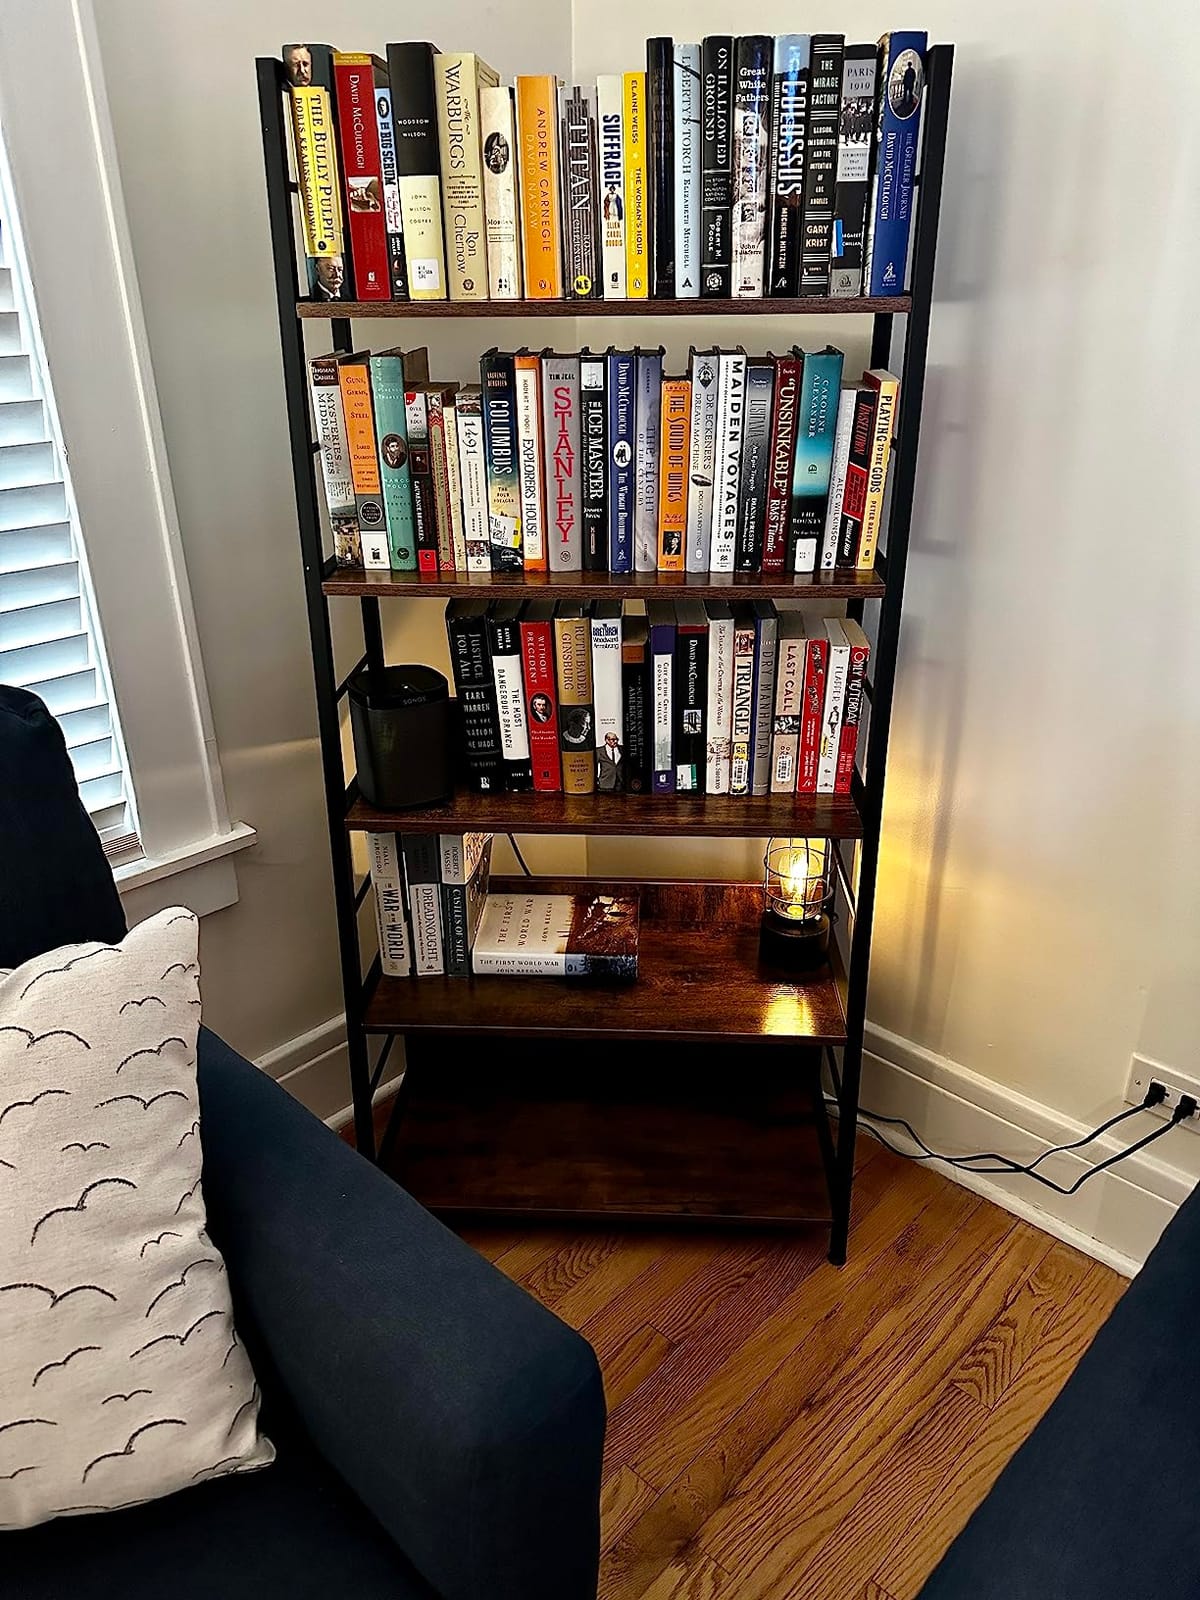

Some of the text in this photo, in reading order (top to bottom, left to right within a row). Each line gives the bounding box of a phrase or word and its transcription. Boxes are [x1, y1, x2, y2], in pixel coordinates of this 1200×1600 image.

[738, 80, 766, 90] White
[739, 67, 765, 77] Great
[813, 77, 839, 88] MIRAGE
[821, 60, 833, 70] THE
[847, 67, 874, 77] PARIS
[849, 82, 871, 90] 1919
[349, 75, 360, 104] DAVID
[705, 73, 716, 141] GROUND
[717, 48, 728, 165] ON HALLOWED
[735, 93, 770, 103] Fathers
[811, 94, 838, 105] FACTORY
[397, 118, 430, 126] WOODROW
[445, 60, 467, 169] WARBURGS
[381, 130, 391, 152] BIG
[568, 117, 591, 212] TITAN
[603, 114, 622, 188] SUFFRAGE
[682, 128, 693, 174] TORCH
[294, 98, 317, 240] DORIS KEARNS GOODWIN
[310, 95, 336, 241] THE BULLY PULPIT
[383, 152, 397, 186] SCRUM
[525, 134, 539, 229] DAVID NASAW
[536, 108, 552, 252] ANDREW CARNEGIE
[881, 132, 897, 220] DAVID McCULLOUGH
[900, 146, 914, 219] GREATER JOURNEY
[454, 214, 467, 275] Chernow
[467, 230, 480, 257] Ron
[574, 219, 583, 273] CHERNOW
[583, 234, 591, 256] RON
[708, 224, 716, 251] POOLE
[714, 215, 723, 246] ROBERT
[778, 207, 788, 270] MICHAEL HILTZIK
[805, 238, 828, 248] KRIST
[806, 225, 829, 235] GARY
[618, 363, 629, 385] DAVID
[351, 412, 370, 420] STEEL
[670, 395, 685, 412] THE
[727, 360, 744, 442] MAIDEN
[808, 374, 821, 437] ALEXANDER
[817, 380, 830, 433] CAROLINE
[318, 393, 336, 475] MIDDLE AGES
[326, 393, 343, 461] MYSTERIES
[462, 420, 479, 456] 1491
[488, 400, 513, 474] COLUMBUS
[667, 417, 688, 451] SOUND
[692, 393, 702, 471] DREAM MACHINE
[704, 393, 714, 470] DR. ECKENER'S
[854, 402, 874, 455] TINSELTOWN
[869, 395, 893, 494] PLAYING GODS
[552, 387, 576, 543] STANLEY
[588, 409, 604, 501] ICE MASTER
[645, 425, 656, 515] THE FLIGHT
[669, 456, 683, 469] OF
[522, 439, 538, 538] EXPLORERS HOUSE
[667, 472, 684, 503] WINGS
[723, 450, 739, 541] VOYAGES
[769, 499, 780, 521] RMS
[836, 478, 845, 500] ALEC
[868, 500, 876, 521] PETER
[618, 485, 629, 544] WRIGHT BROTHERS
[747, 520, 756, 553] PRESTON
[766, 523, 779, 553] Titanic
[830, 501, 842, 548] WILKINSON
[457, 634, 471, 679] FOR ALL
[468, 634, 484, 679] JUSTICE
[527, 631, 538, 684] PRECEDENT
[537, 635, 548, 679] WITHOUT
[562, 632, 575, 691] GINSBURG
[574, 626, 588, 698] RUTH BADER
[688, 640, 698, 660] DAVID
[465, 692, 485, 700] EARL
[716, 670, 725, 726] CENTER WORLD
[734, 661, 752, 736] TRIANGLE
[783, 645, 798, 712] LAST CALL
[844, 652, 867, 725] ONLY YESTERDAY
[464, 703, 490, 712] WARREN
[498, 668, 513, 749] DANGEROUS BRANCH
[512, 689, 523, 728] THE MOST
[629, 686, 638, 757] AMERICAN ELITE
[757, 651, 774, 759] DRY MANHATTAN
[373, 838, 384, 874] FERGUSON
[382, 847, 390, 867] NIALL
[443, 849, 452, 875] MASSIE
[451, 846, 460, 872] ROBERT
[382, 888, 405, 960] WAR WORLD
[422, 887, 439, 962] DREADNOUGHT
[452, 889, 465, 964] CASTLES OF STEEL
[497, 900, 515, 944] THE FIRST
[518, 897, 535, 947] WORLD WAR
